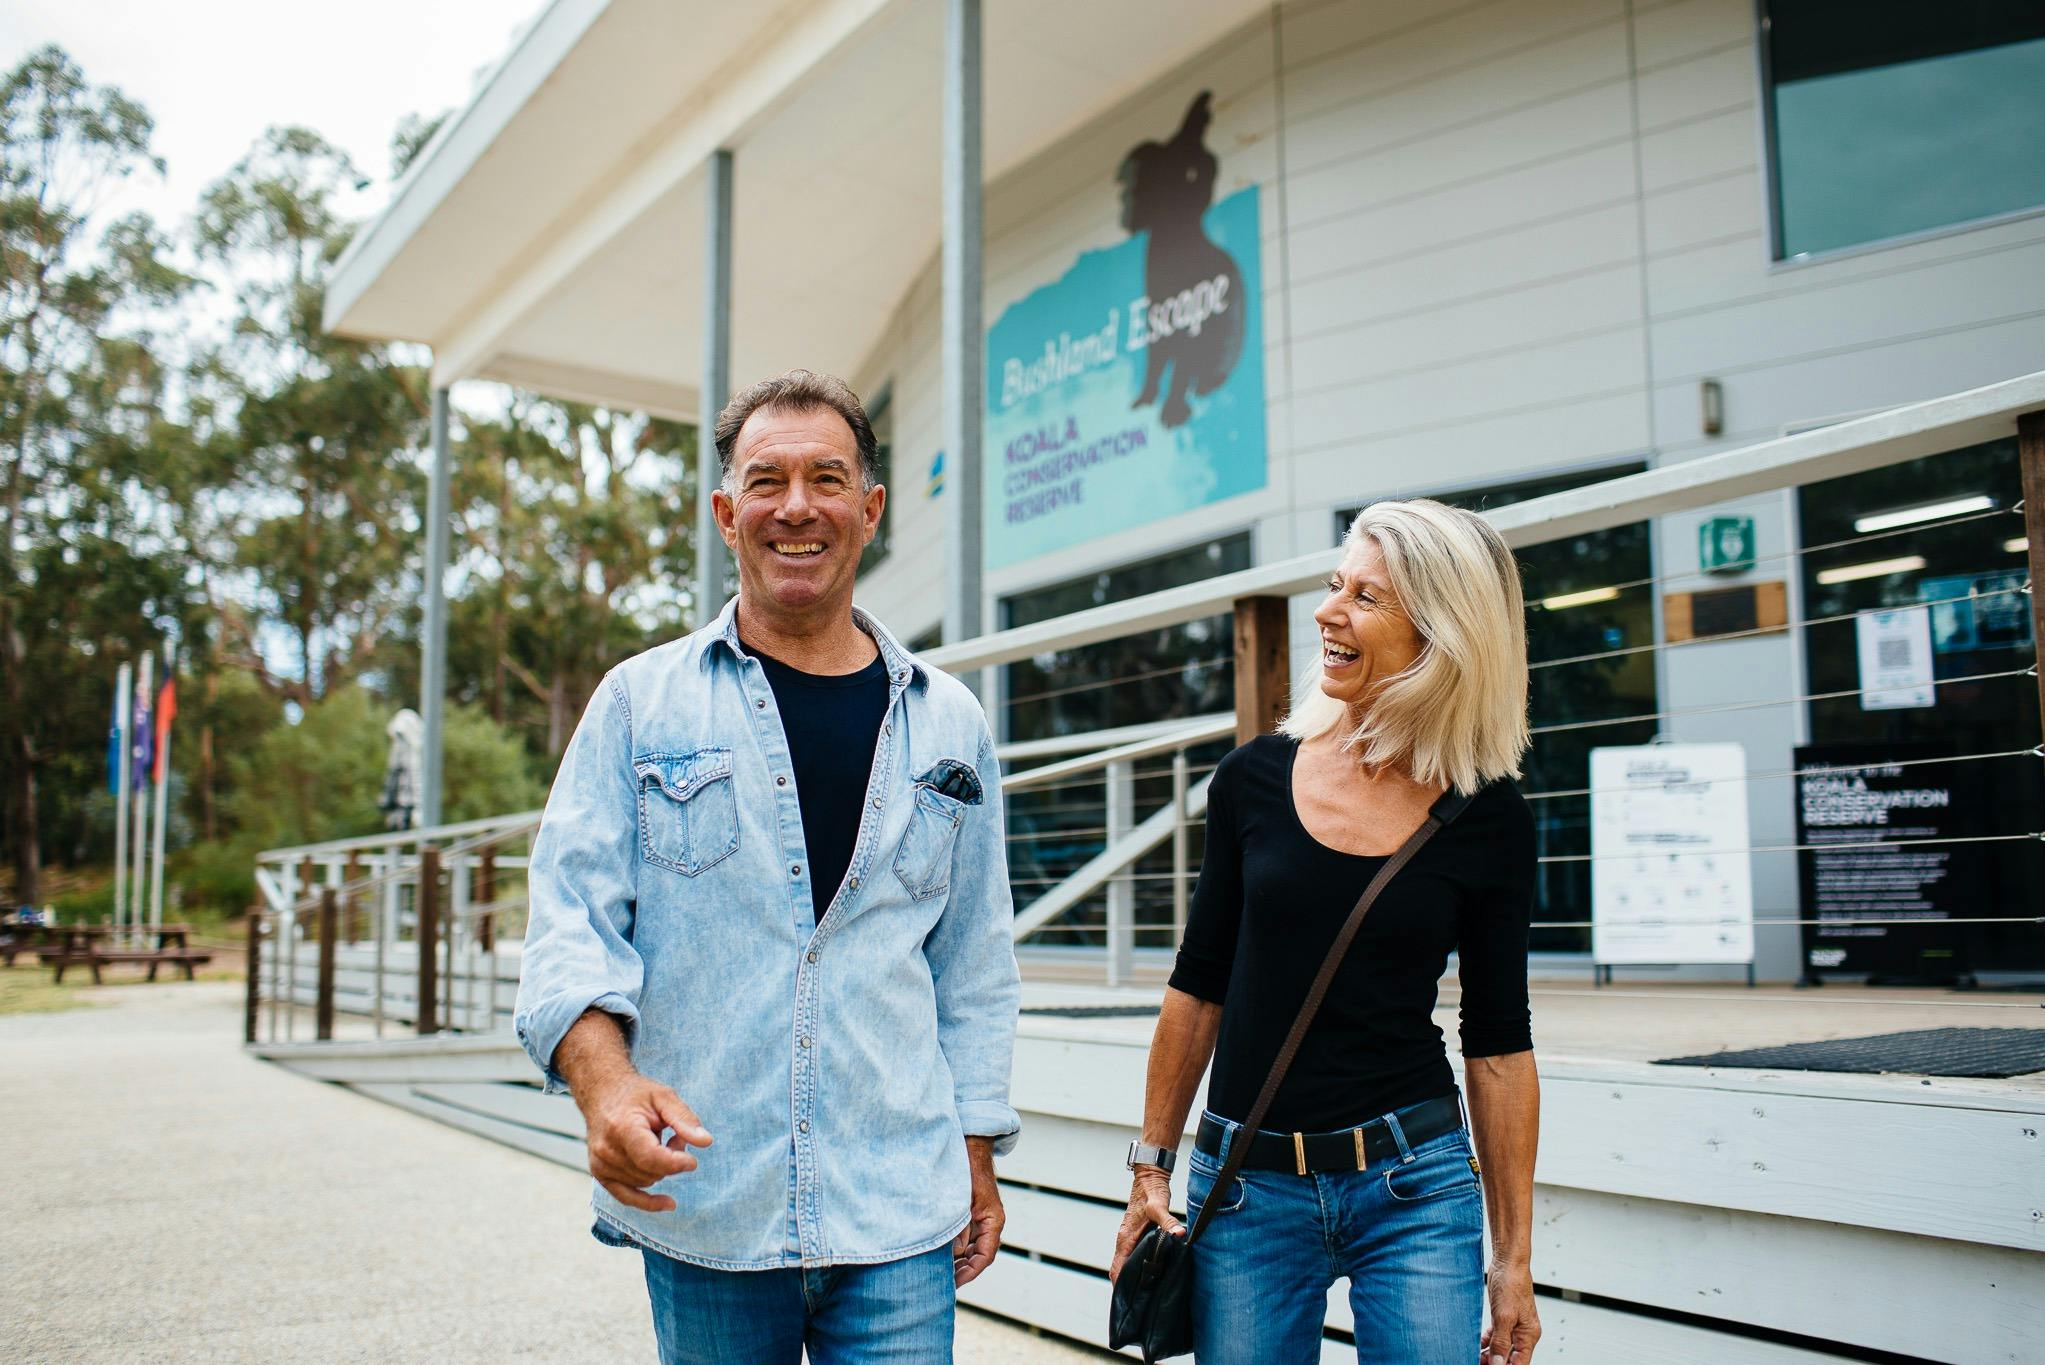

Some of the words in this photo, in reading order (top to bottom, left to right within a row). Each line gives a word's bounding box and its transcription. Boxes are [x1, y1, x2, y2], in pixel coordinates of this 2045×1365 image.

[1001, 308, 1120, 407] Bushland
[1126, 273, 1230, 352] Escape
[1005, 416, 1079, 466] KOALA
[1005, 425, 1148, 497] CONSERVATION
[1006, 479, 1083, 526] RESERVE
[1802, 778, 1867, 793] KOALA
[1803, 789, 1949, 809] CONSERVATION
[1804, 809, 1888, 826] RESERVE
